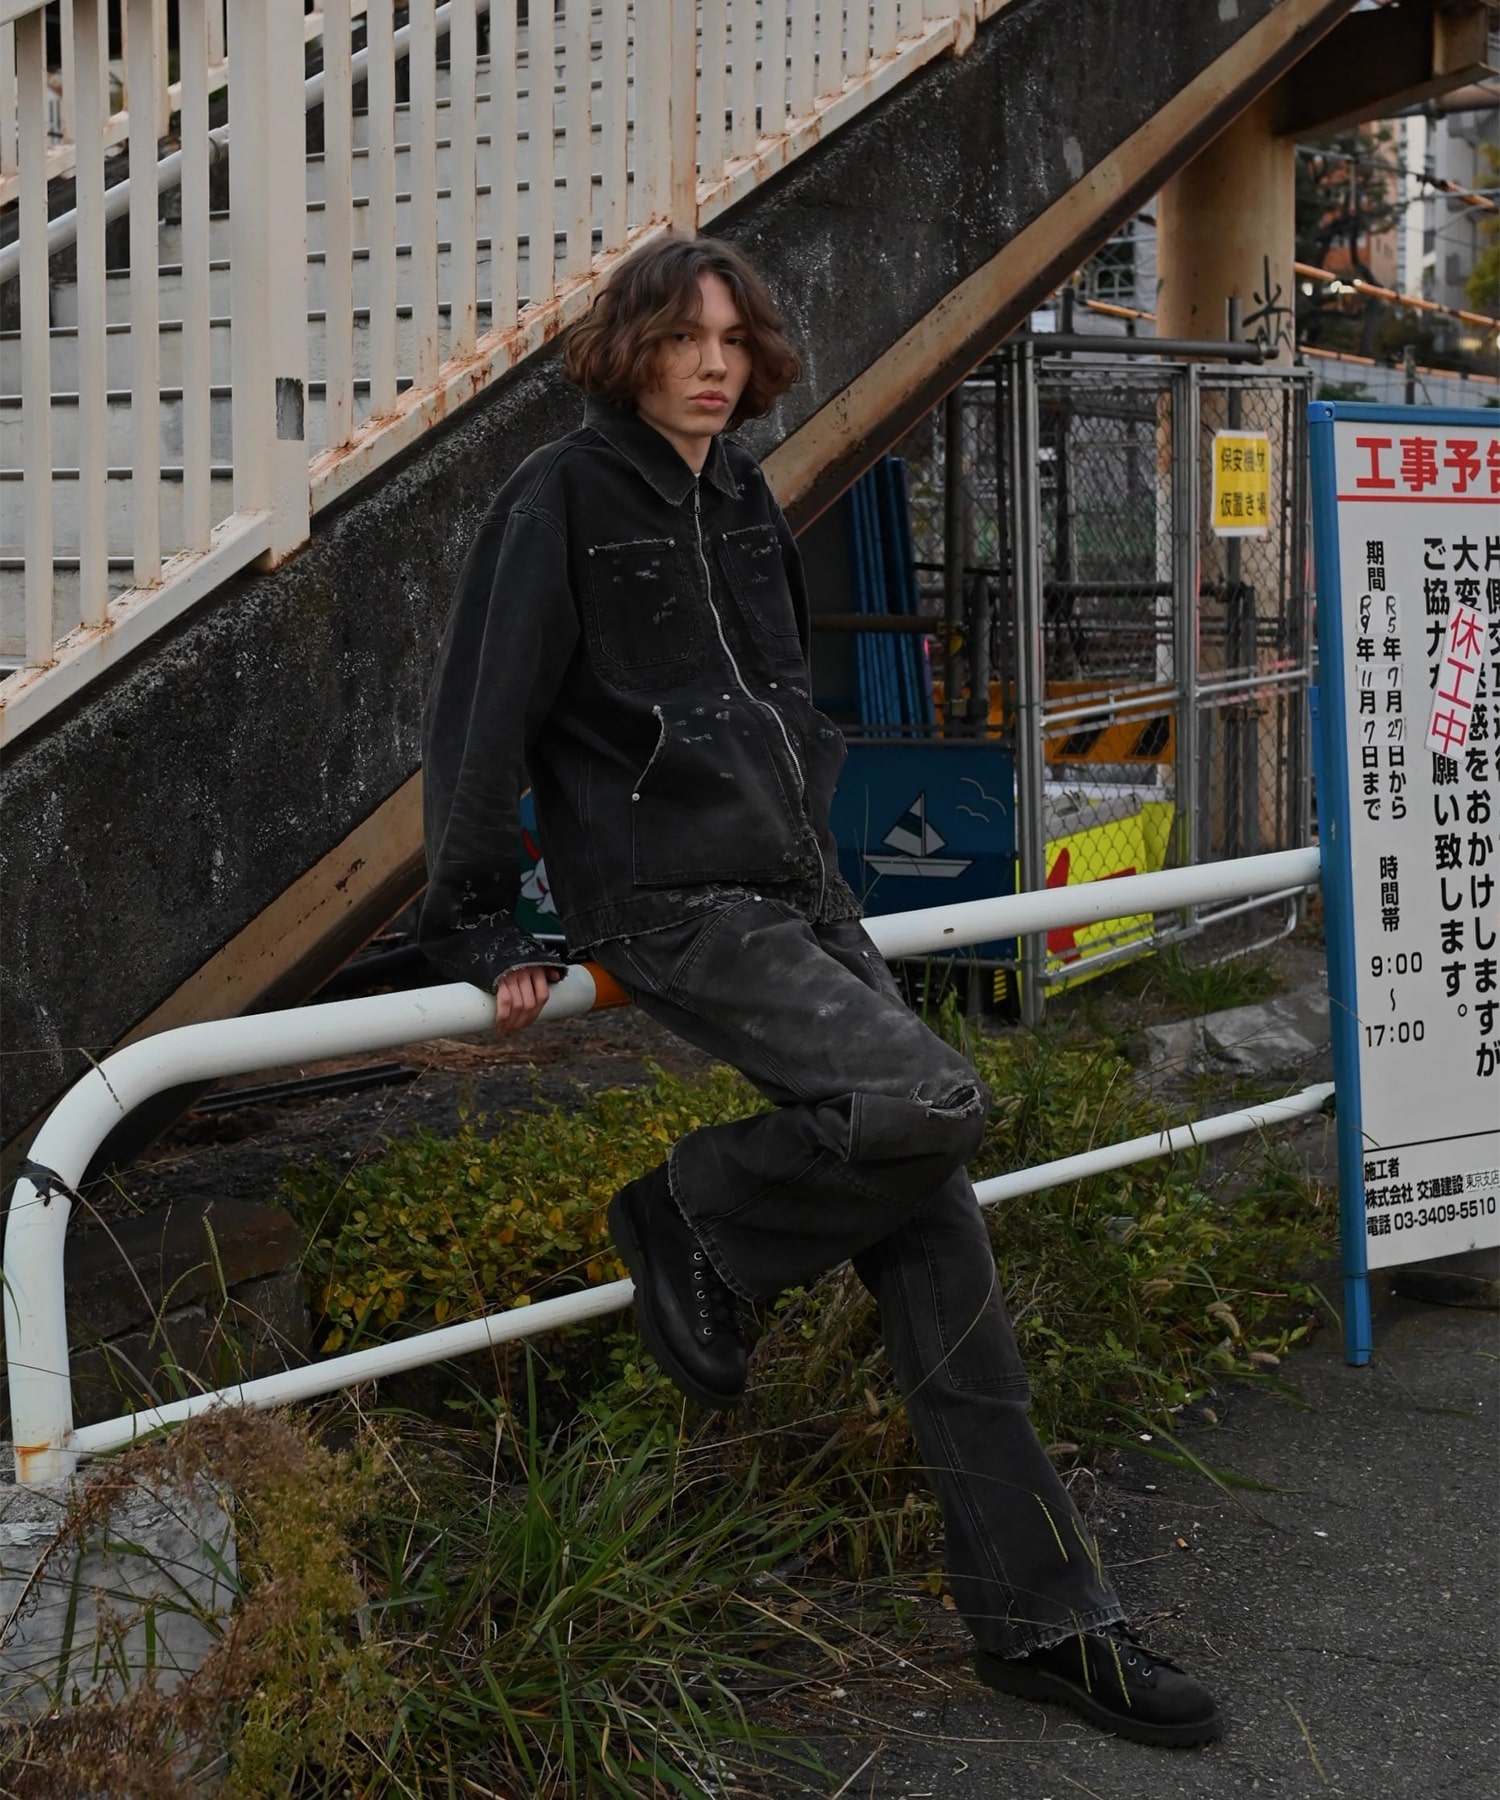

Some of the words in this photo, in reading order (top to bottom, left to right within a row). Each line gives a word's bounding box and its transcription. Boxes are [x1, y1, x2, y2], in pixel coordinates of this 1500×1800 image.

[1366, 540, 1386, 591] 期間
[1431, 607, 1484, 755] 休工中
[1380, 855, 1400, 932] 時間帯
[1371, 952, 1423, 977] 9:00
[1365, 1020, 1425, 1047] 17:00
[1364, 1157, 1400, 1182] 施工者
[1365, 1182, 1414, 1209] 株式会社
[1416, 1174, 1464, 1201] 交通建設
[1366, 1213, 1391, 1236] 電話
[1394, 1196, 1496, 1231] 03-3409-5510
